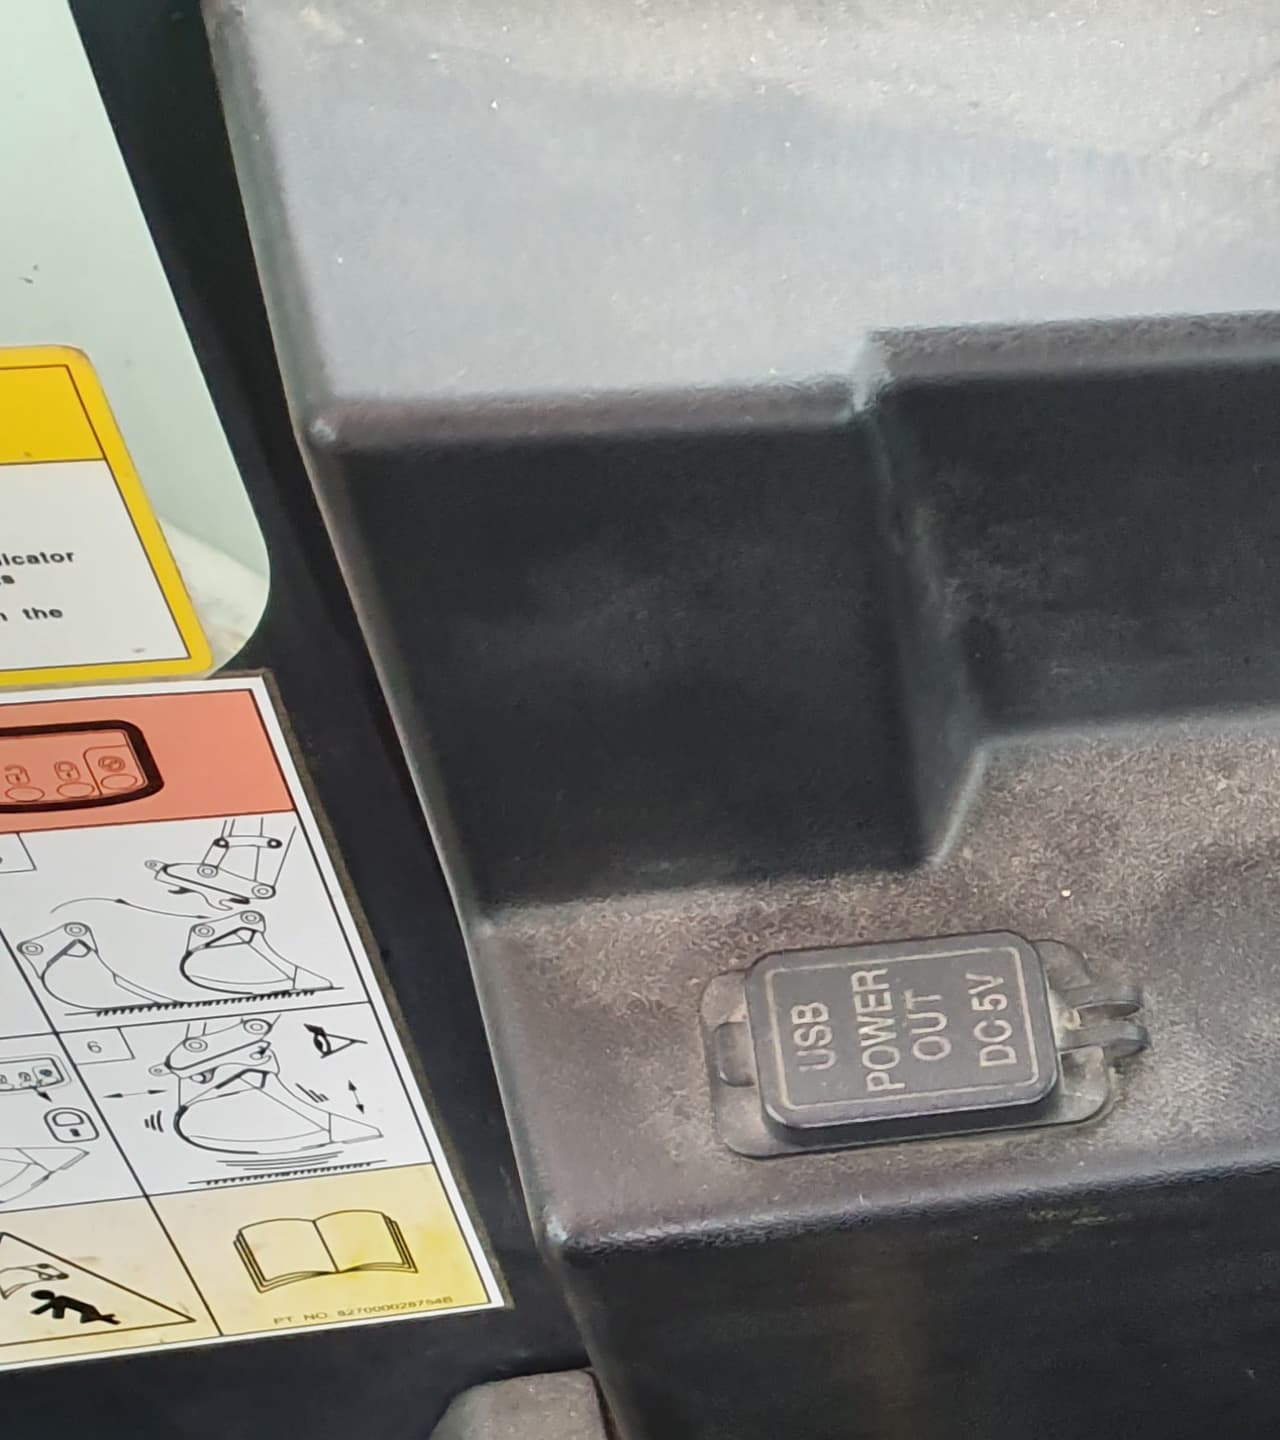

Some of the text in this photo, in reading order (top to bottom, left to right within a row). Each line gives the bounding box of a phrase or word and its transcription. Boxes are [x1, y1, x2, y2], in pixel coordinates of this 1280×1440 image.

[22, 607, 63, 620] the
[87, 1041, 102, 1053] 6
[790, 1002, 837, 1071] USB
[850, 968, 905, 1092] POWER
[905, 990, 951, 1061] OUT
[965, 973, 1017, 1068] DC 5V
